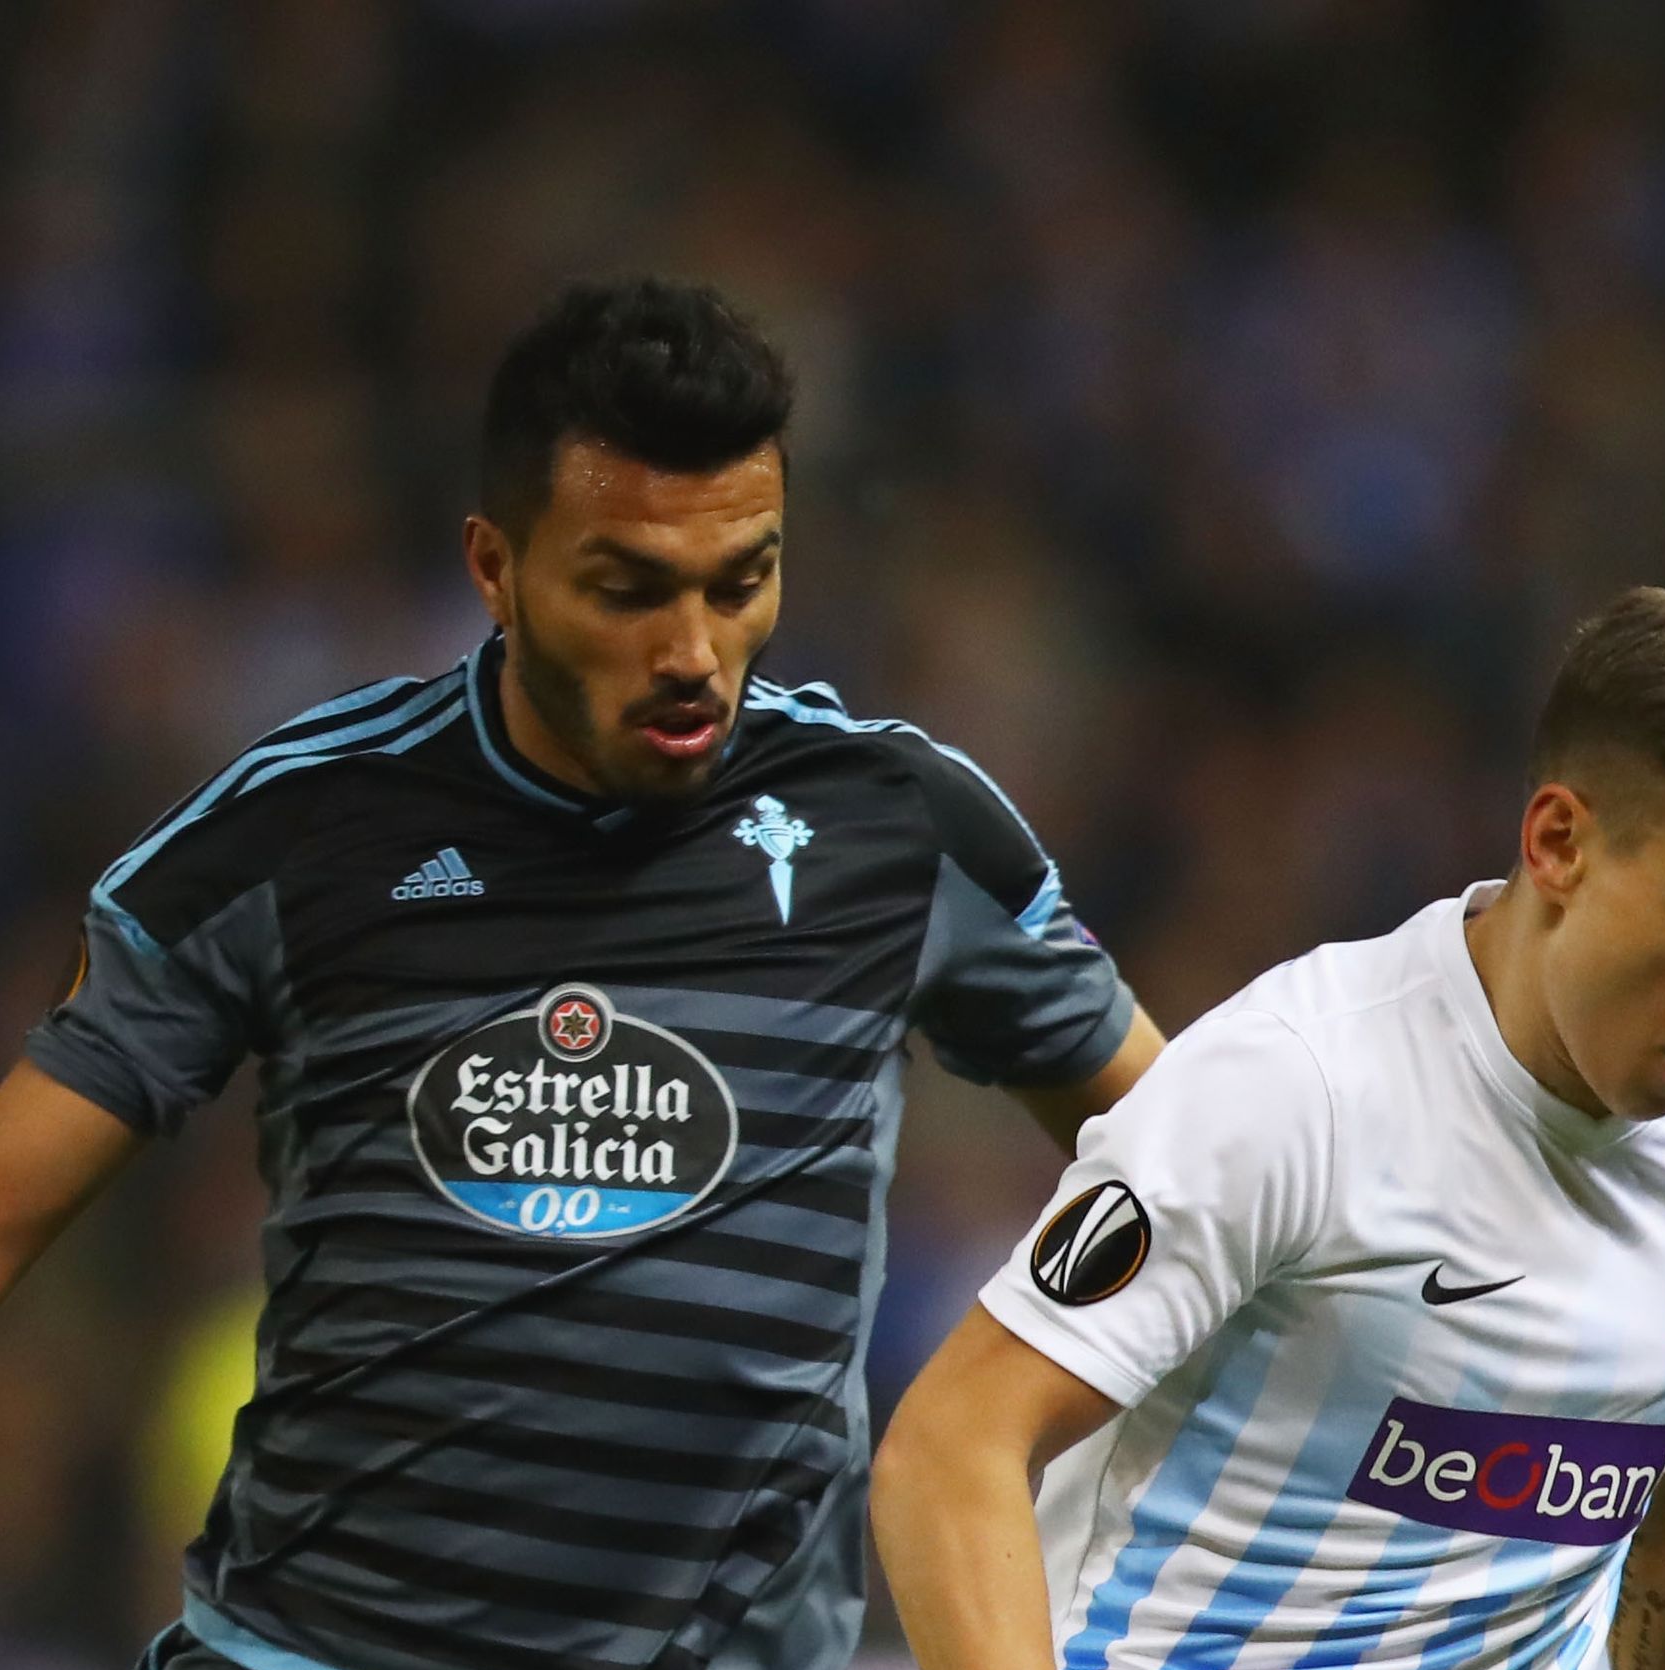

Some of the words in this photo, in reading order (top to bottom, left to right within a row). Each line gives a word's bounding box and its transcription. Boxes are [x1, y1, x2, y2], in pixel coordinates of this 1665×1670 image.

[391, 880, 485, 900] adidas
[450, 1053, 692, 1122] Estrella
[465, 1116, 677, 1184] Galicia
